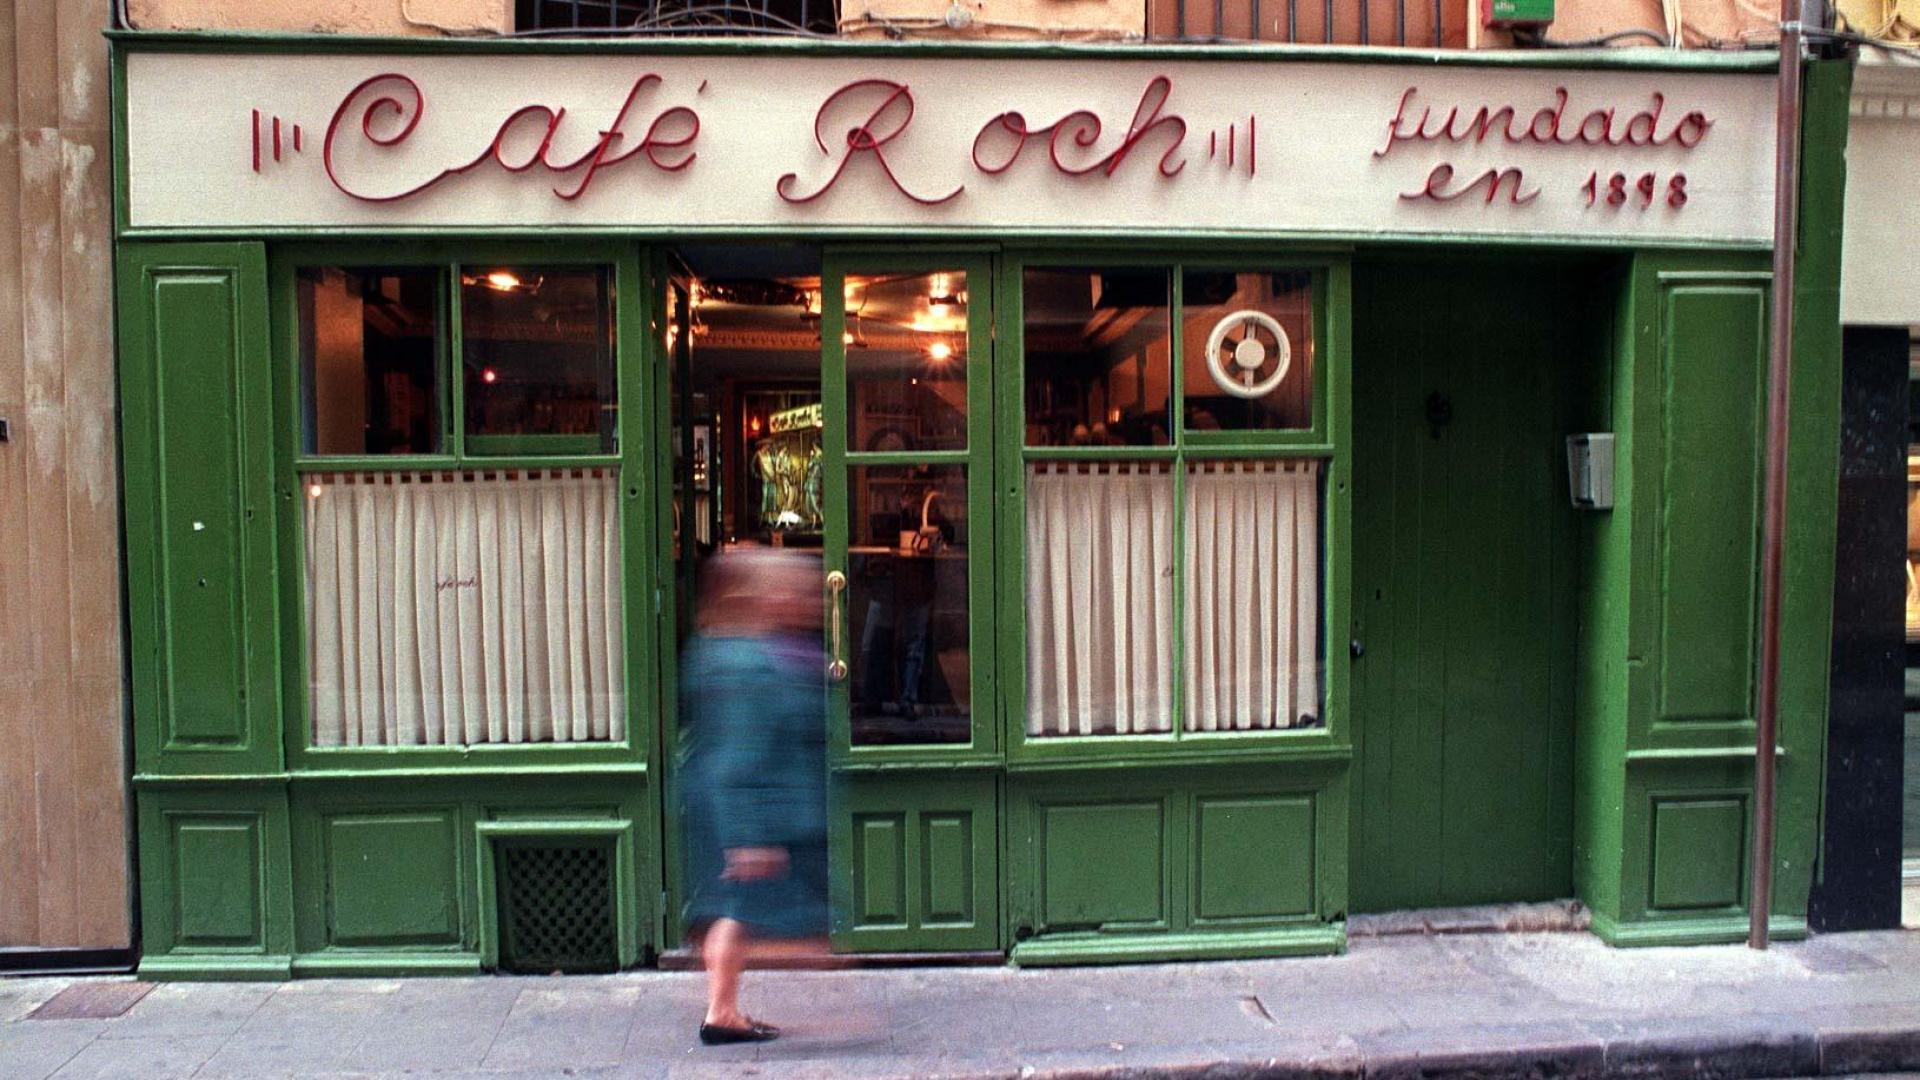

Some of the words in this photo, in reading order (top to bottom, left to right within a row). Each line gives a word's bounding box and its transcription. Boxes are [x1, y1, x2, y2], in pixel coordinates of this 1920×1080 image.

[322, 72, 708, 203] Café
[777, 72, 1187, 205] Roch
[1372, 86, 1716, 158] fundado
[1399, 162, 1542, 205] en
[1580, 170, 1689, 209] 1898
